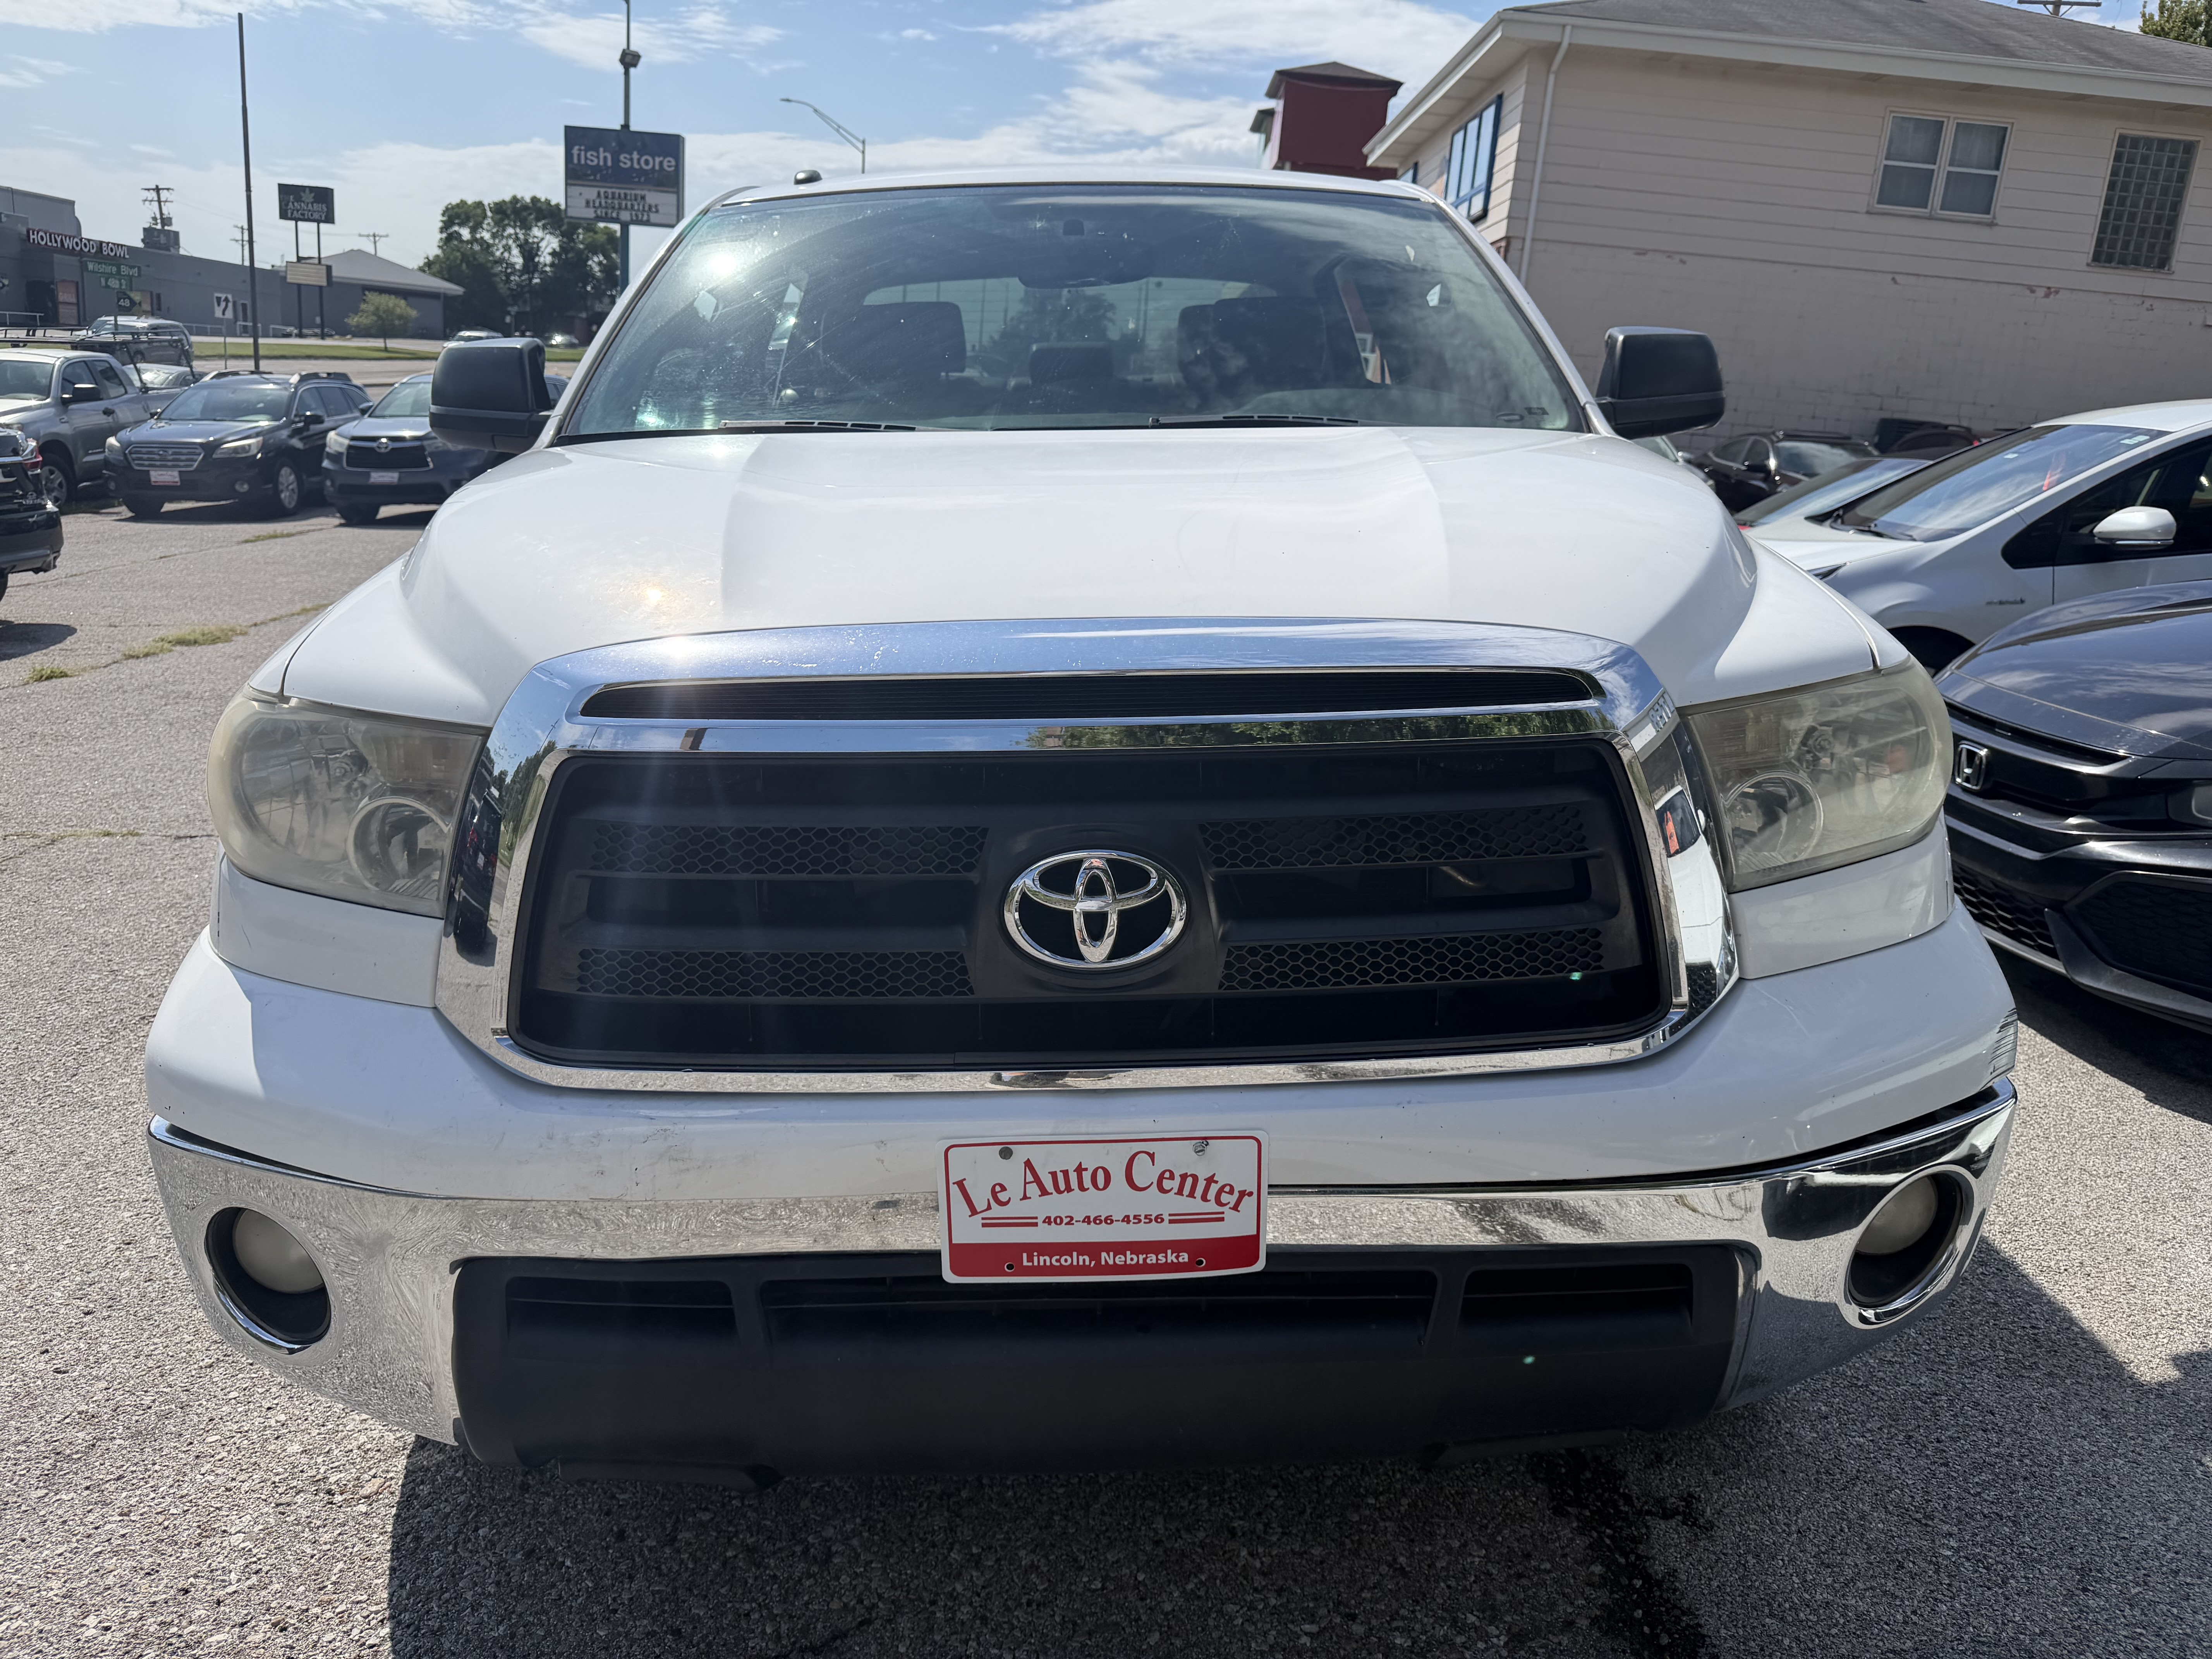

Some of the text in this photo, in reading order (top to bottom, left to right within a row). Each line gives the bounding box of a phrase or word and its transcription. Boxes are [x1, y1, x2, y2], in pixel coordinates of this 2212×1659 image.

[571, 145, 676, 171] fish store
[287, 210, 326, 220] FACTORY
[30, 230, 130, 258] HOLLYWOOD BOWL
[87, 261, 138, 276] Wilshire Blvd
[118, 298, 130, 307] 48
[953, 1150, 1254, 1218] Le Auto Center
[1042, 1213, 1165, 1226] 402-466-4556
[1022, 1249, 1189, 1267] Lincoln, Nebraska
